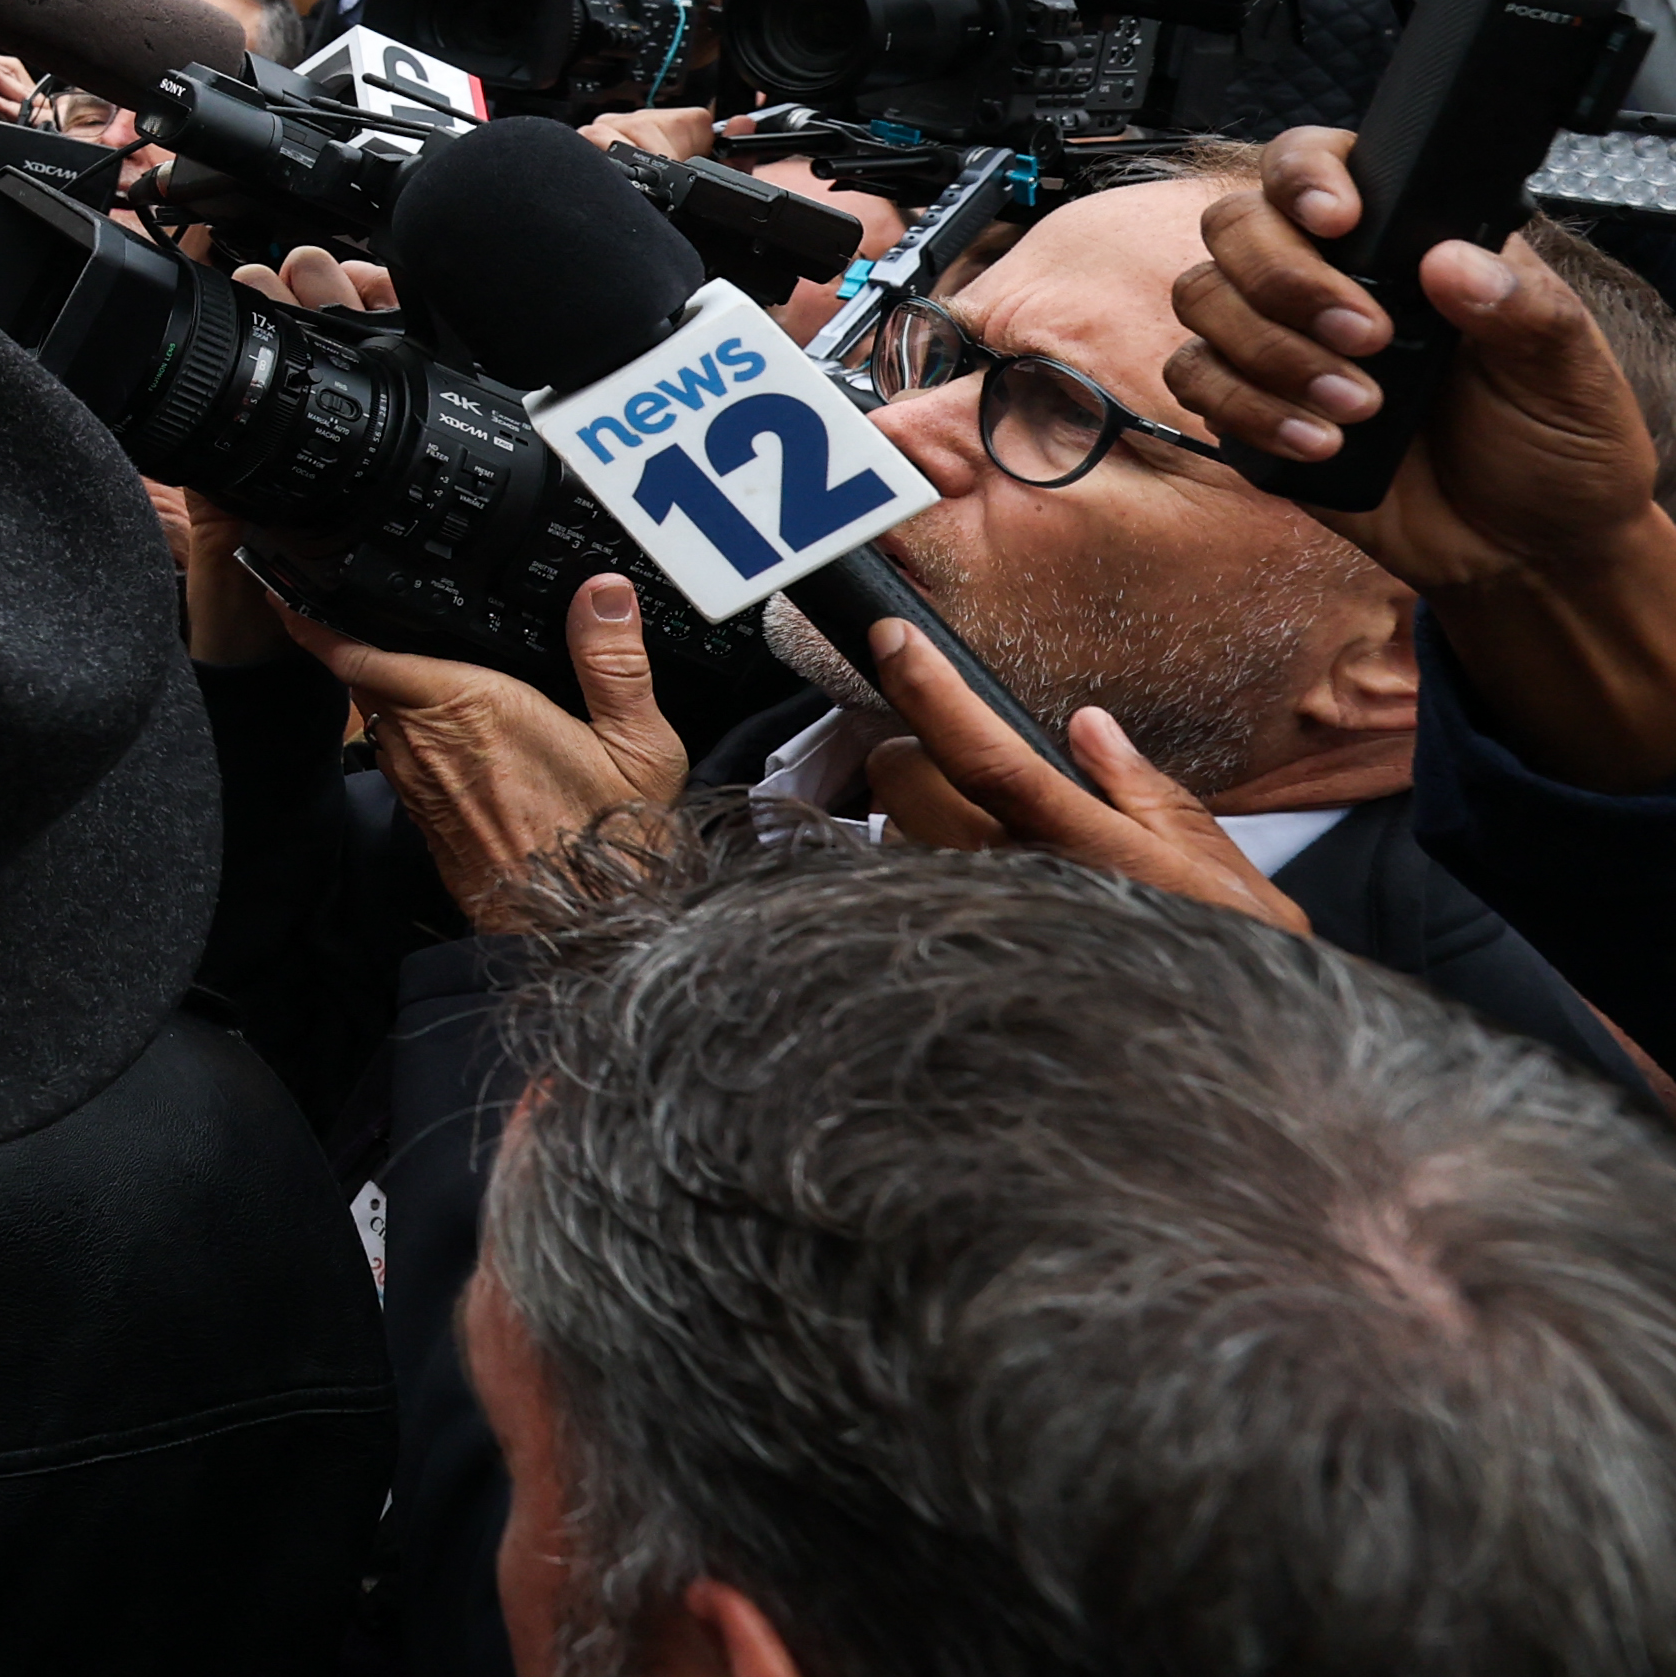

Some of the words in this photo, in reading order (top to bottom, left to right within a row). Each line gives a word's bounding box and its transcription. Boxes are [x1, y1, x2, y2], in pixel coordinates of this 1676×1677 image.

[159, 77, 187, 97] SONY
[23, 159, 78, 180] XDCAM
[439, 391, 484, 417] 4K
[576, 337, 767, 466] news
[315, 427, 341, 443] MACRO
[438, 412, 488, 441] XDCAM
[426, 447, 450, 463] FILTER
[633, 391, 898, 582] 12
[571, 539, 581, 549] 3
[413, 579, 423, 589] 9
[452, 595, 465, 607] 10
